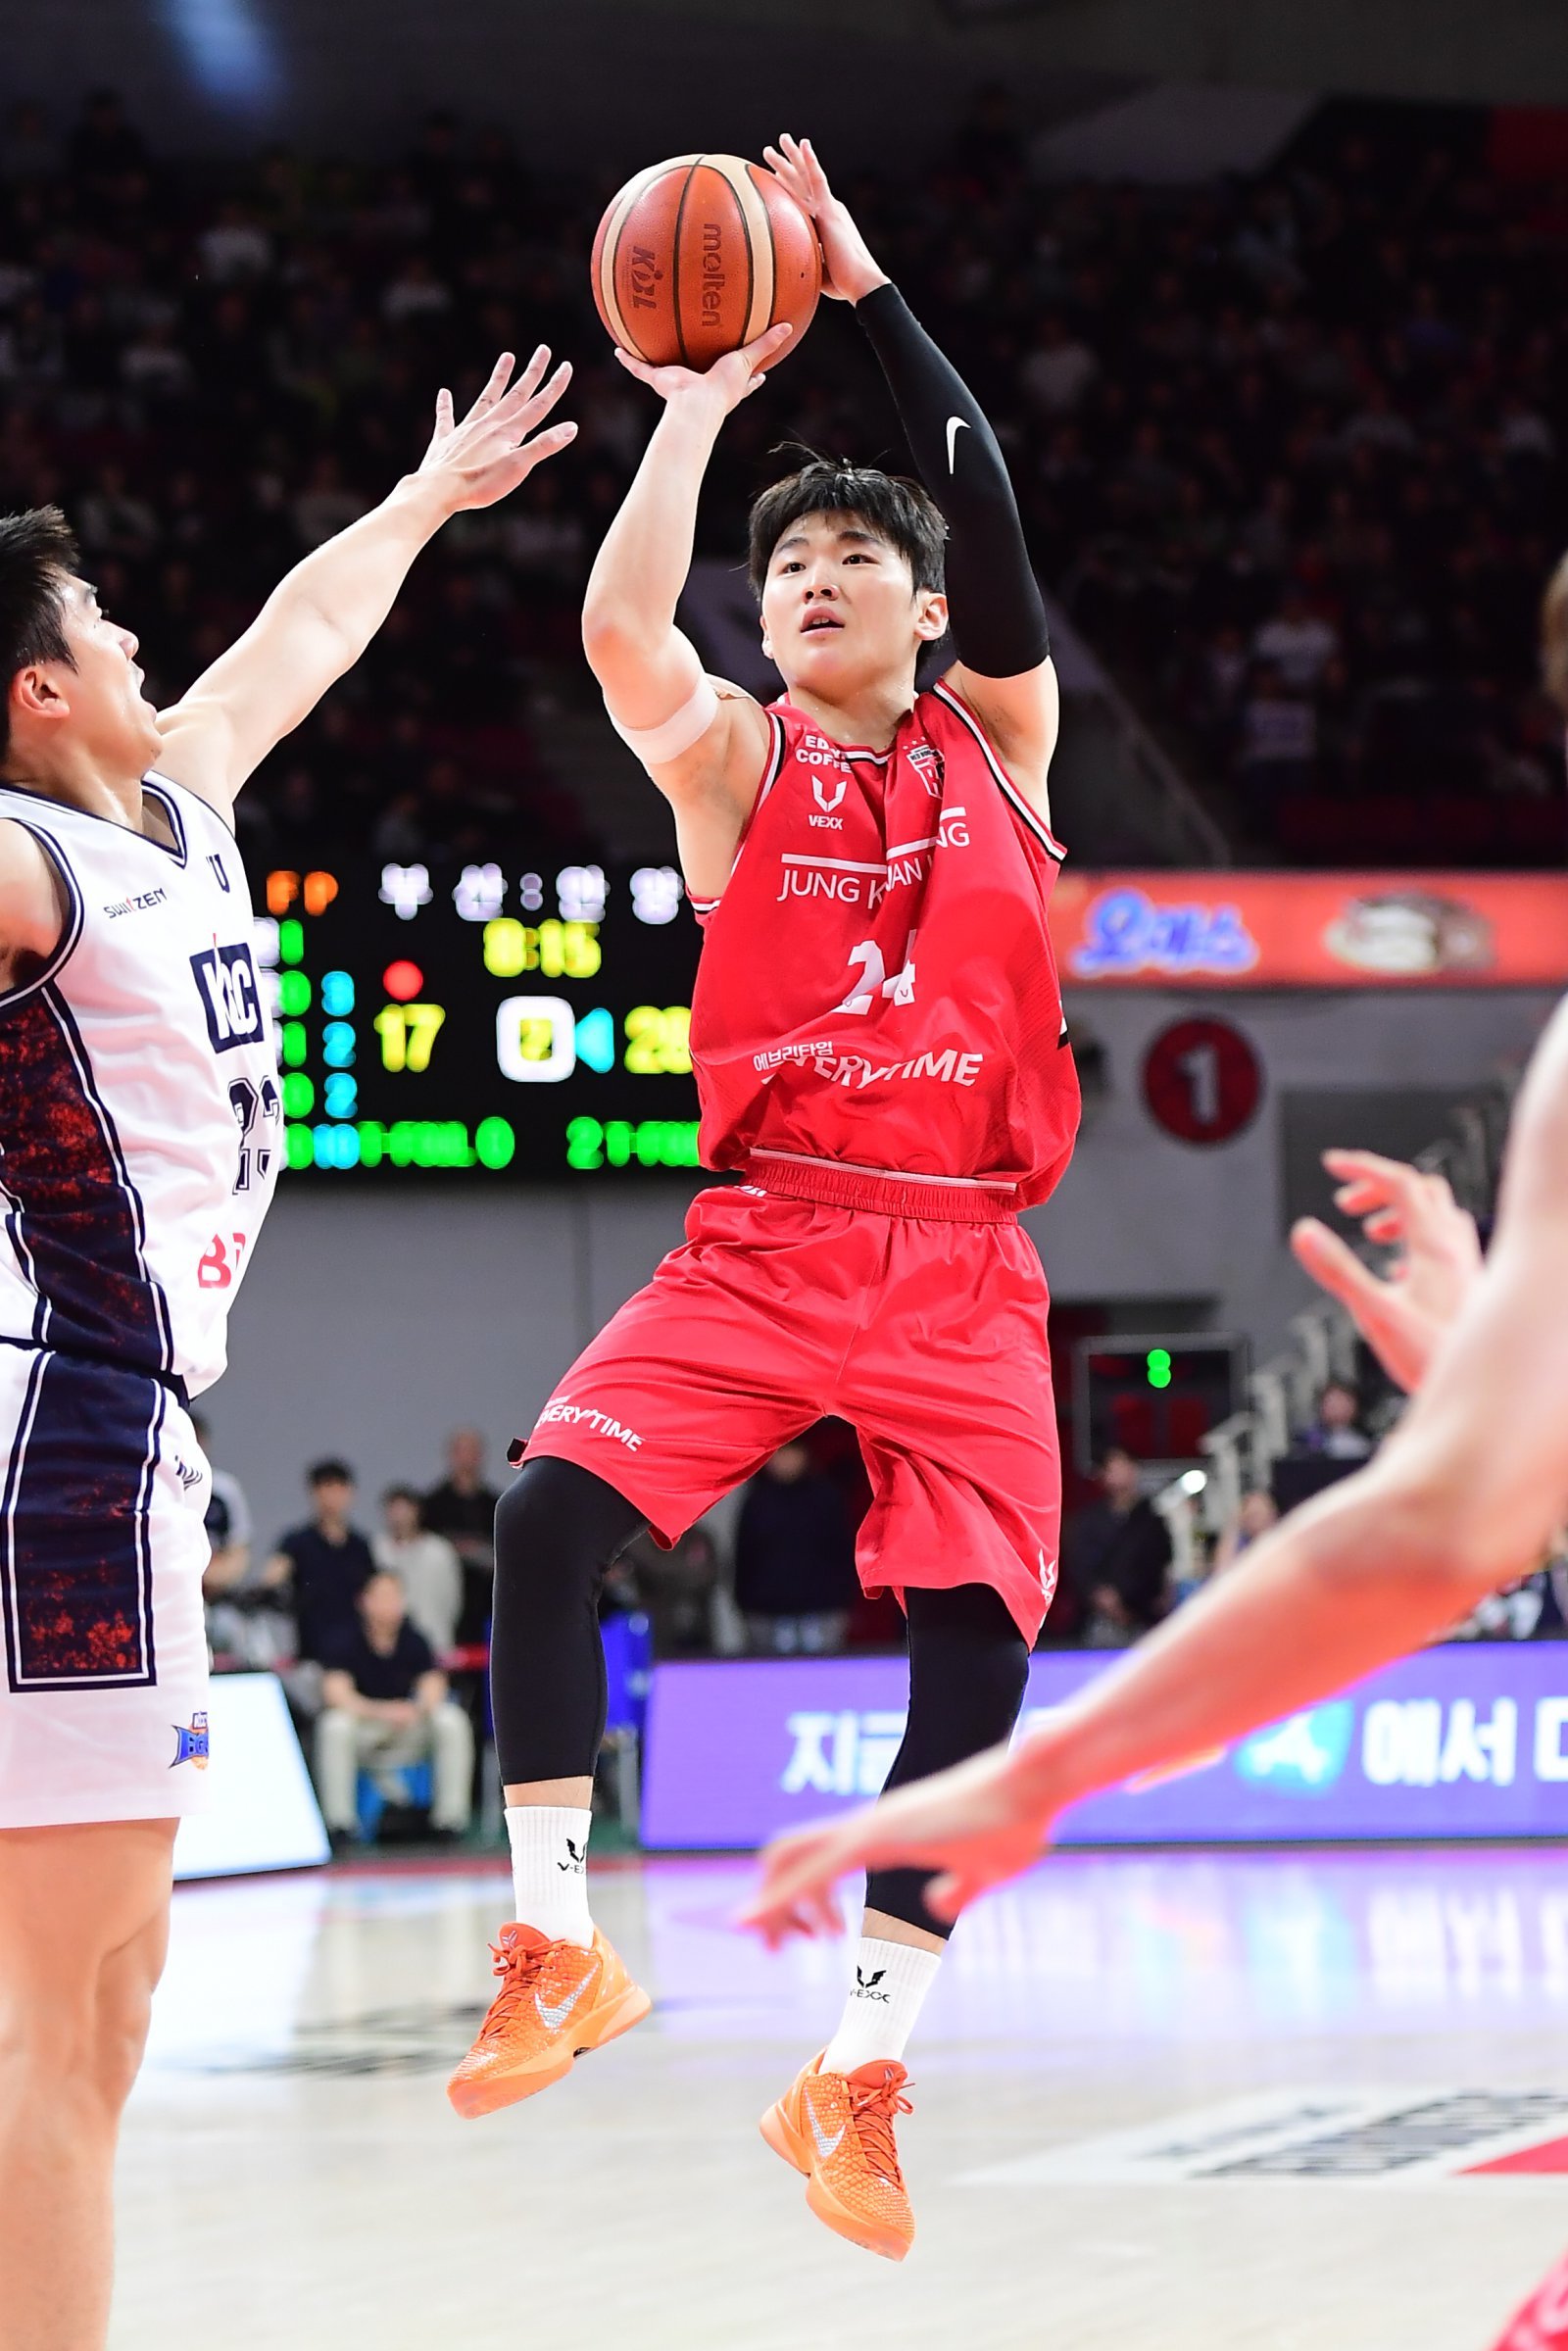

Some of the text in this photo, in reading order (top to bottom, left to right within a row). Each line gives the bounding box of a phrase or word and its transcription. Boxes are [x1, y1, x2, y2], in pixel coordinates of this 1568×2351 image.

[702, 223, 726, 327] molten
[776, 869, 860, 903] JUNG
[832, 929, 917, 1016] 24
[373, 1004, 446, 1073] 17
[753, 1040, 834, 1072] 에브리타임
[1179, 1044, 1218, 1124] 1
